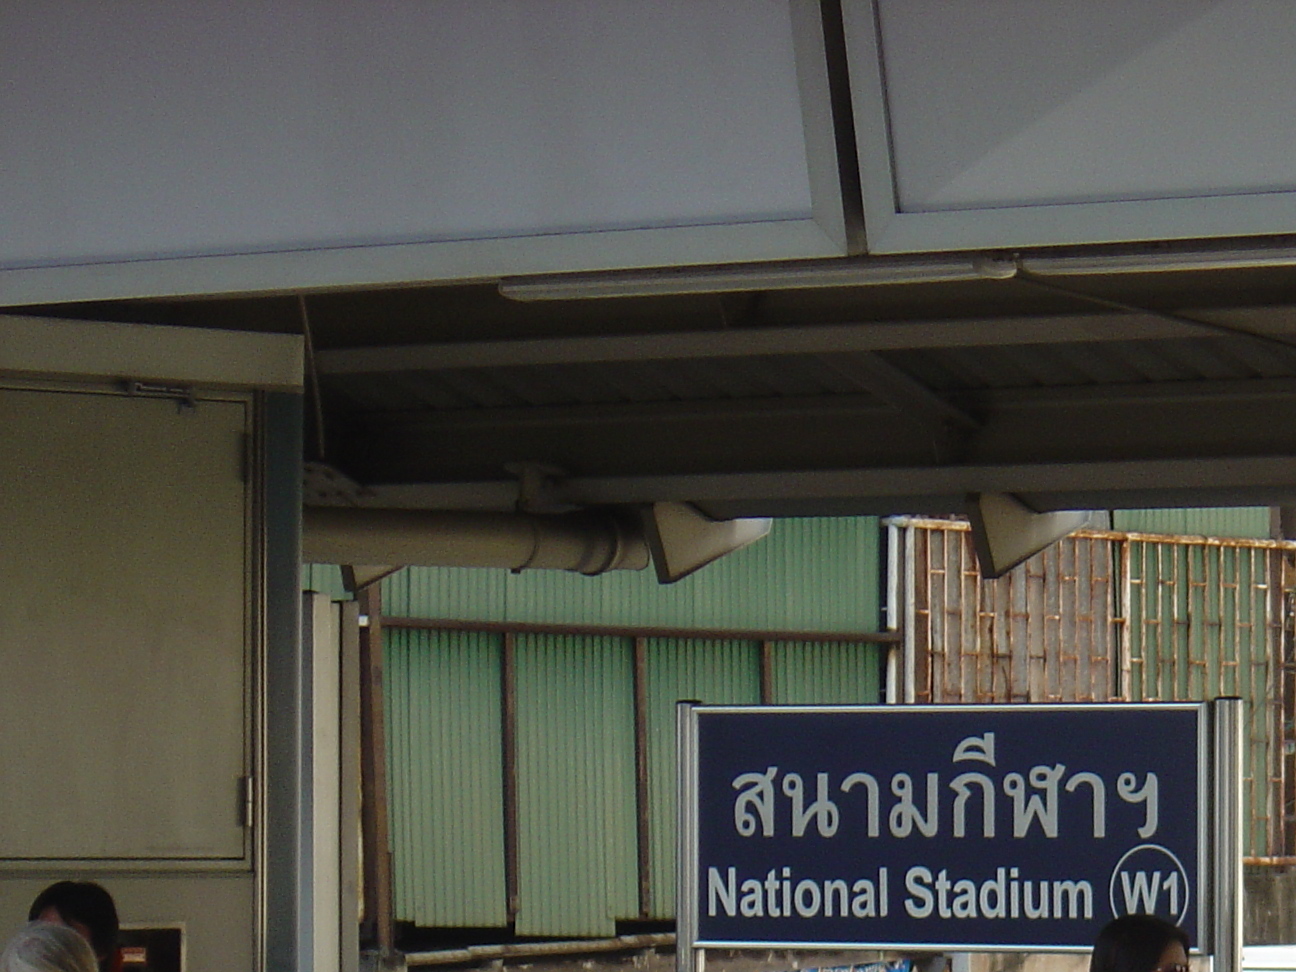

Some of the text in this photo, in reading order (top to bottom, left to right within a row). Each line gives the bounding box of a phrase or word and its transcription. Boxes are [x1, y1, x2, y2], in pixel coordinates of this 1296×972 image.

[732, 732, 1159, 839] สนามกีฬาฯ
[708, 866, 1178, 919] National Stadium W1
